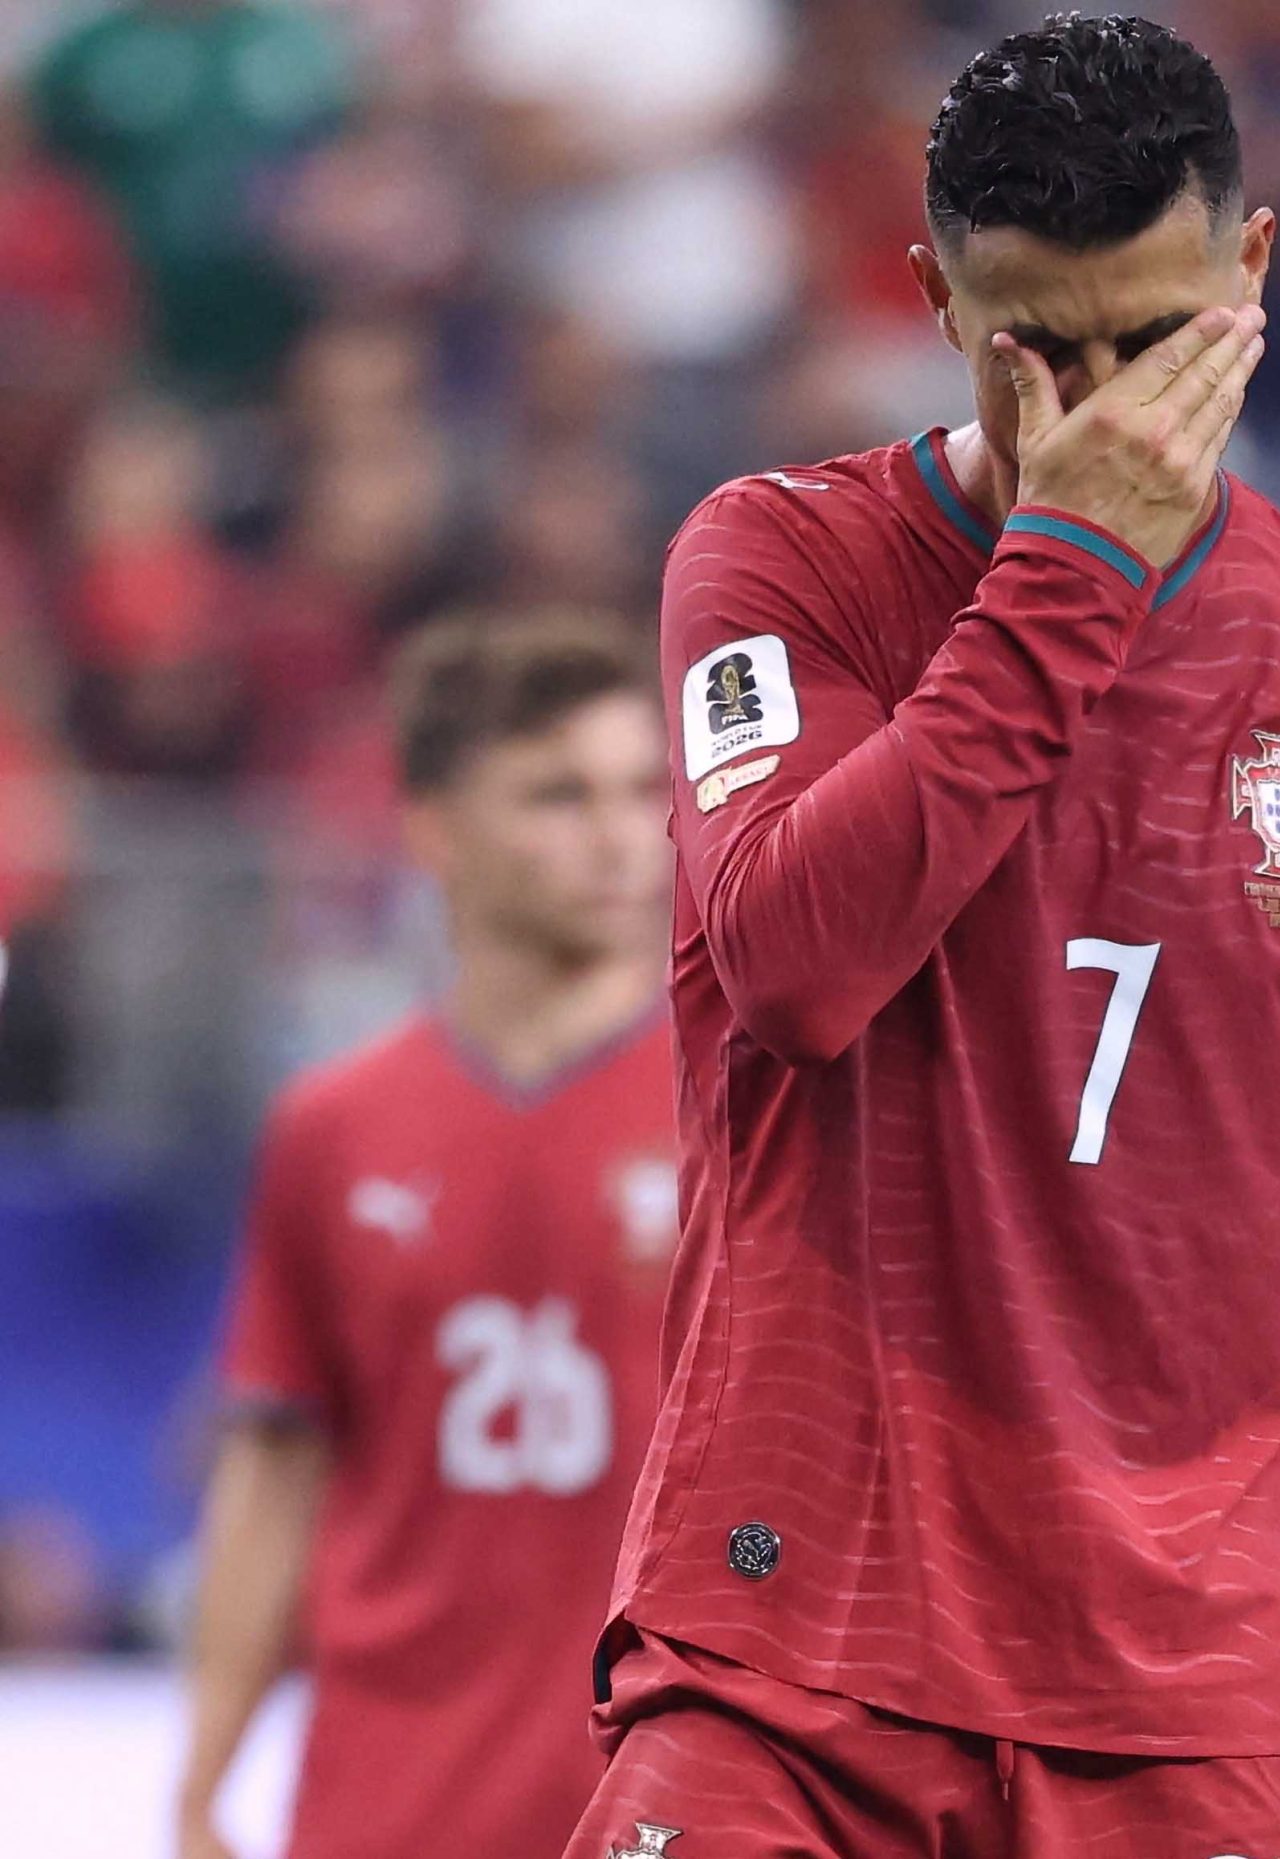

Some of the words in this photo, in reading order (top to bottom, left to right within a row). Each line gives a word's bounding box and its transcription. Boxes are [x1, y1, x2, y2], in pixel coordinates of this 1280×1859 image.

[712, 730, 762, 758] 2026
[1066, 937, 1161, 1165] 7
[434, 1295, 612, 1495] 26
